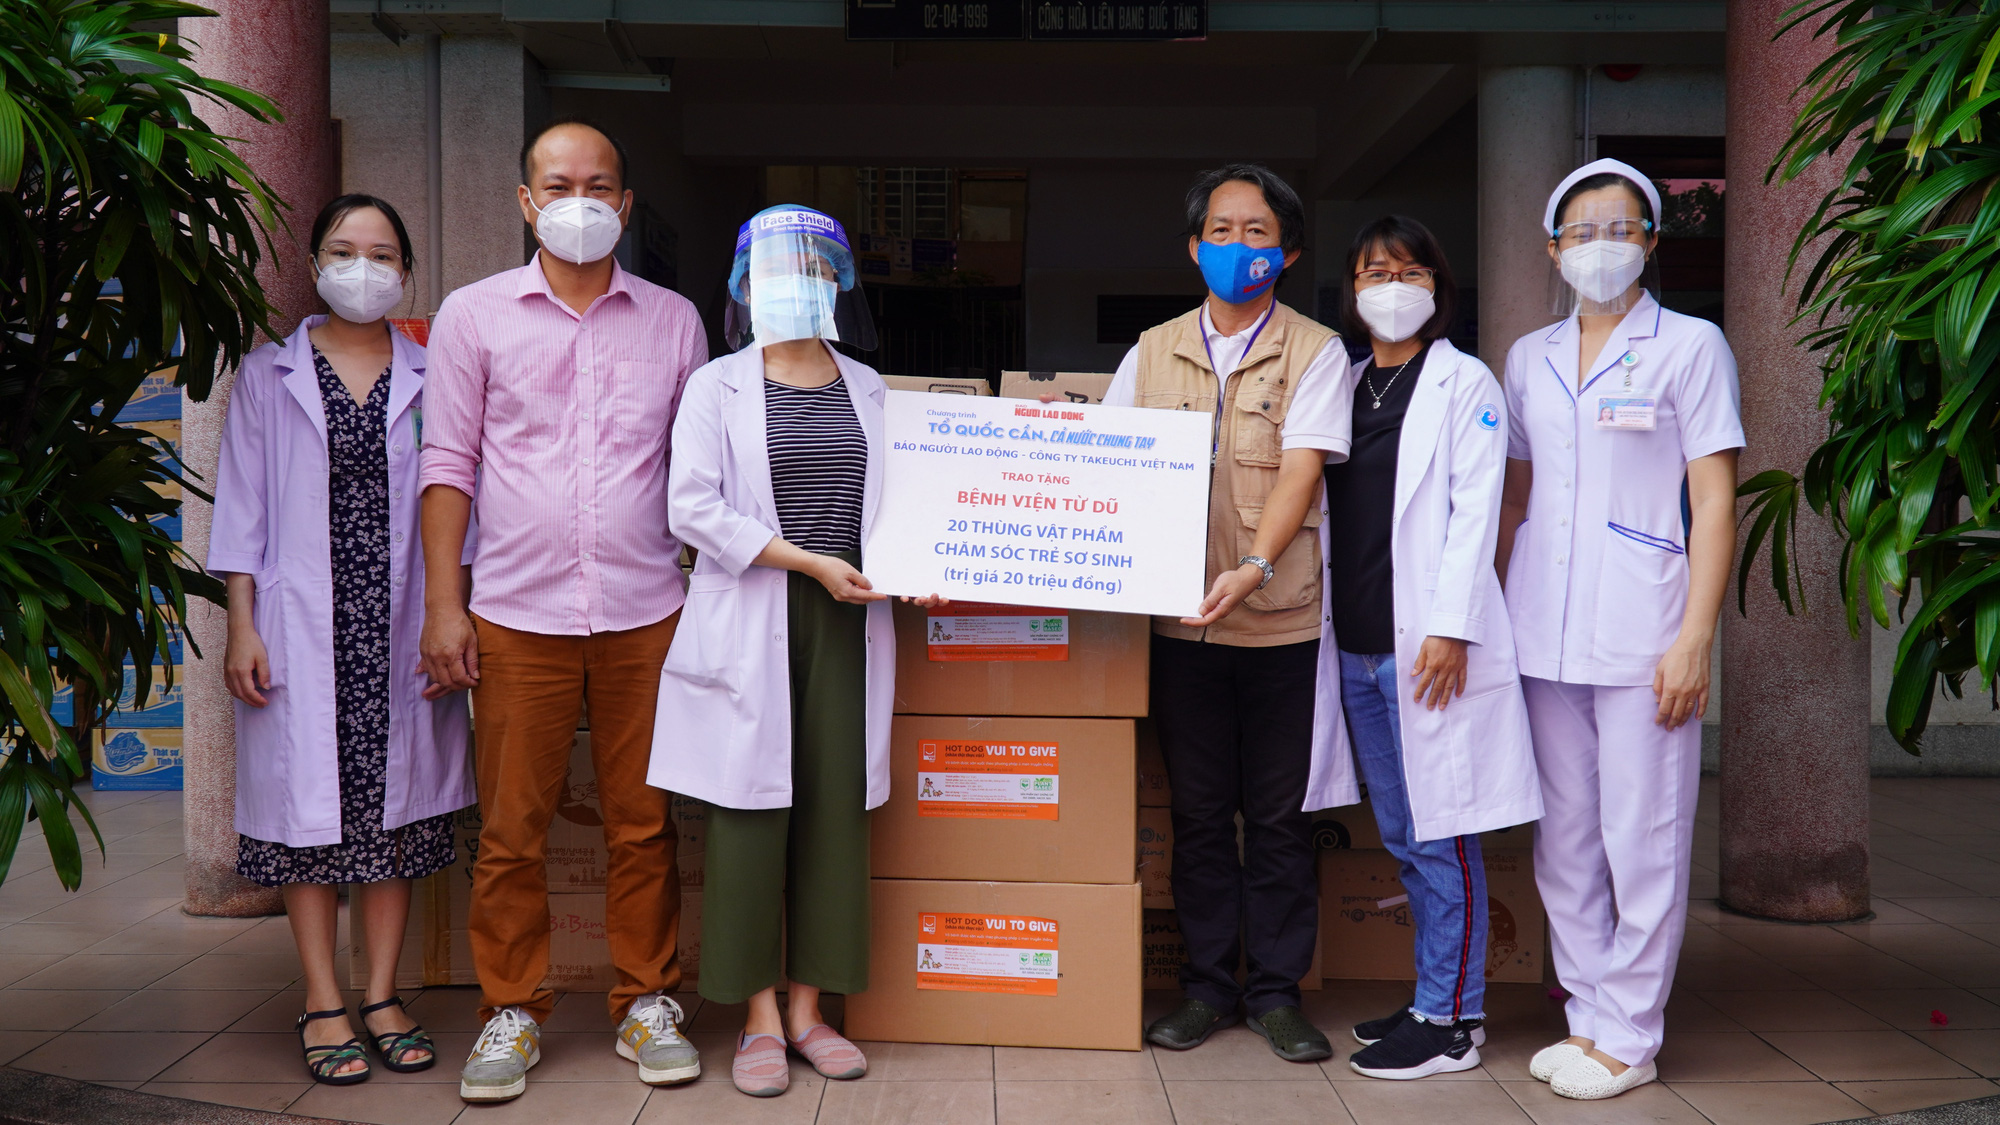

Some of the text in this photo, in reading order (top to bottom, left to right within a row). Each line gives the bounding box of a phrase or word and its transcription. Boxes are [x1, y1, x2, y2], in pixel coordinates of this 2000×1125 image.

[924, 3, 988, 29] 02-04-1996
[1119, 5, 1144, 31] BANG
[763, 213, 833, 229] Face Shield
[927, 409, 977, 419] Chương trình
[1043, 410, 1059, 419] LAO
[928, 418, 1156, 449] TỔ QUỐC CẦN, CẢ NƯỚC CHUNG TAY
[893, 441, 916, 451] BÁO
[920, 443, 957, 454] NGƯỜI
[961, 447, 982, 456] LAO
[986, 447, 1018, 459] ĐỘNG
[1029, 450, 1061, 462] CÔNG
[1064, 454, 1077, 462] TY
[1081, 456, 1137, 467] TAKEUCHI
[1140, 458, 1165, 470] VIỆT
[1169, 461, 1195, 470] NAM
[1002, 472, 1070, 486] TRAO TẶNG
[958, 488, 1118, 514] BỆNH VIỆN TỪ DŨ
[948, 520, 1122, 543] 20 THÙNG VẬT PHẨM
[934, 541, 1132, 568] CHĂM SÓC TRẺ SƠ SINH
[944, 566, 1122, 595] (trị giá 20 triệu đồng)
[985, 745, 1006, 756] VUI
[1010, 746, 1025, 757] TO
[1029, 746, 1057, 757] GIVE
[1340, 896, 1389, 904] arewell
[965, 918, 984, 926] DOG
[985, 918, 1006, 930] VUI
[1010, 920, 1025, 931] TO
[1029, 921, 1057, 932] GIVE
